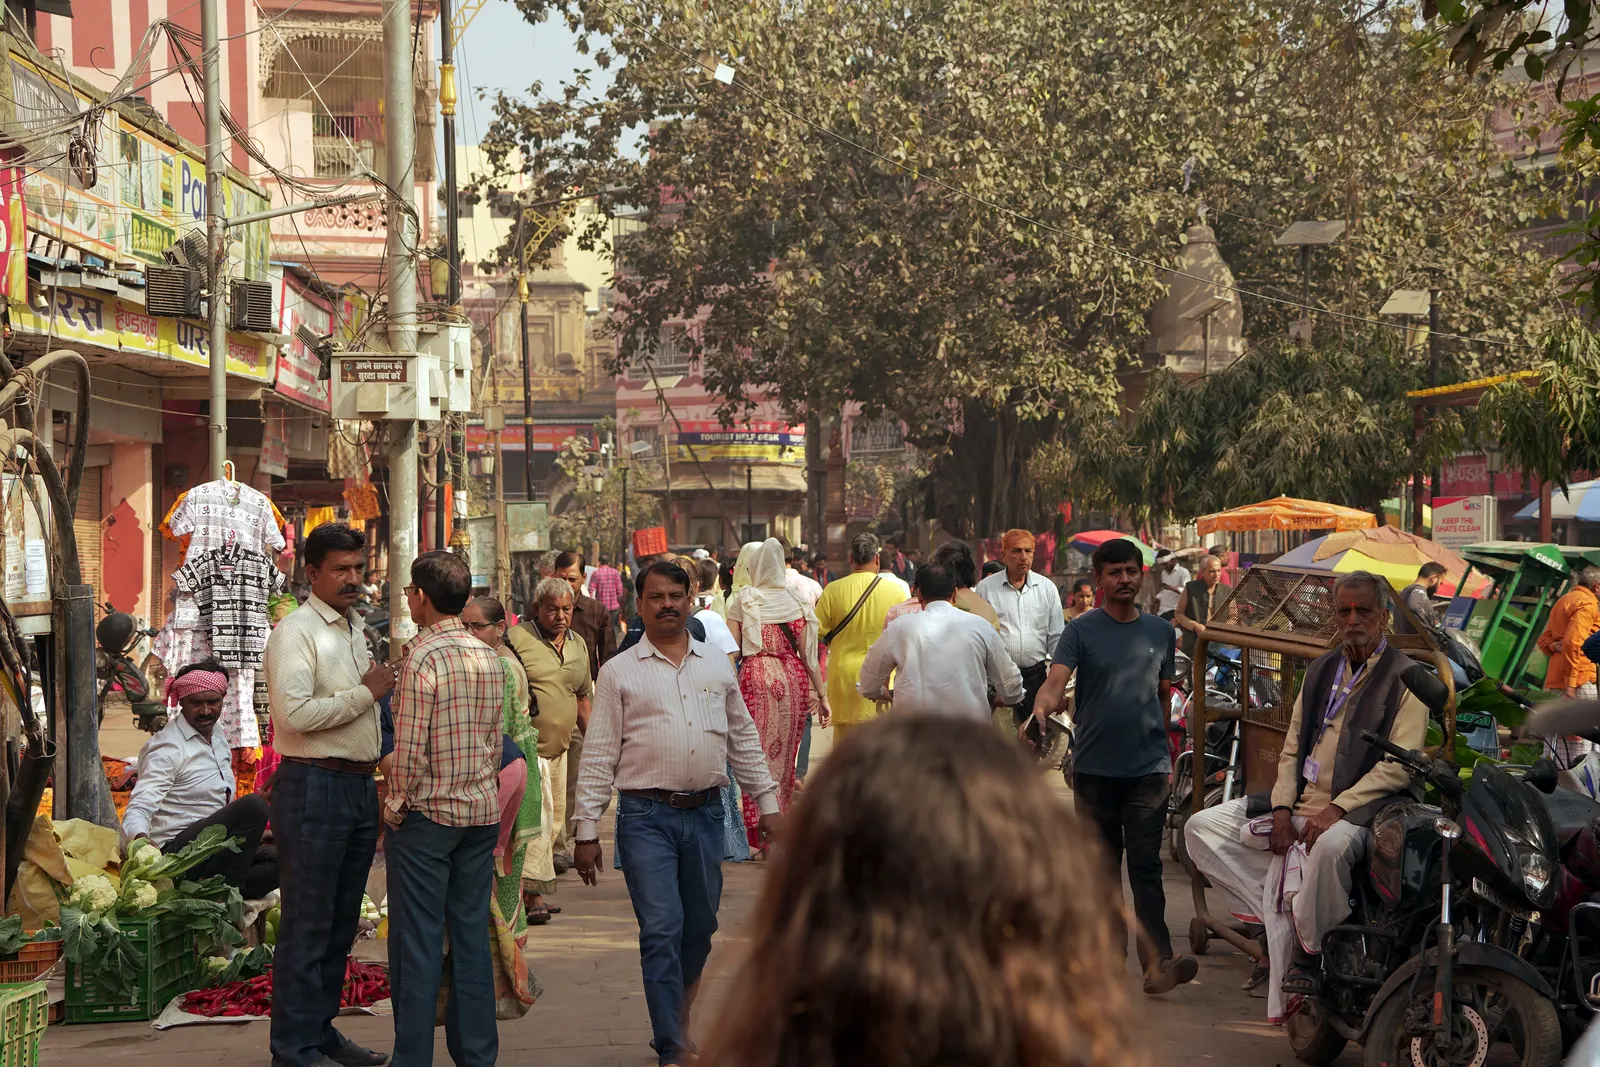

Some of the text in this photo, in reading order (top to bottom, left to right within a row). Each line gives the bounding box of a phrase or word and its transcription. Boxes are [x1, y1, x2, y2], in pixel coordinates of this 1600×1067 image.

[176, 319, 210, 355] पार
[356, 360, 403, 370] अपने सामान की
[358, 370, 402, 382] सुरक्षा स्वयं करें
[701, 433, 780, 442] TOURIST HELP DESK
[1442, 517, 1475, 525] KEEP THE
[1435, 525, 1481, 533] GHATS CLEAN
